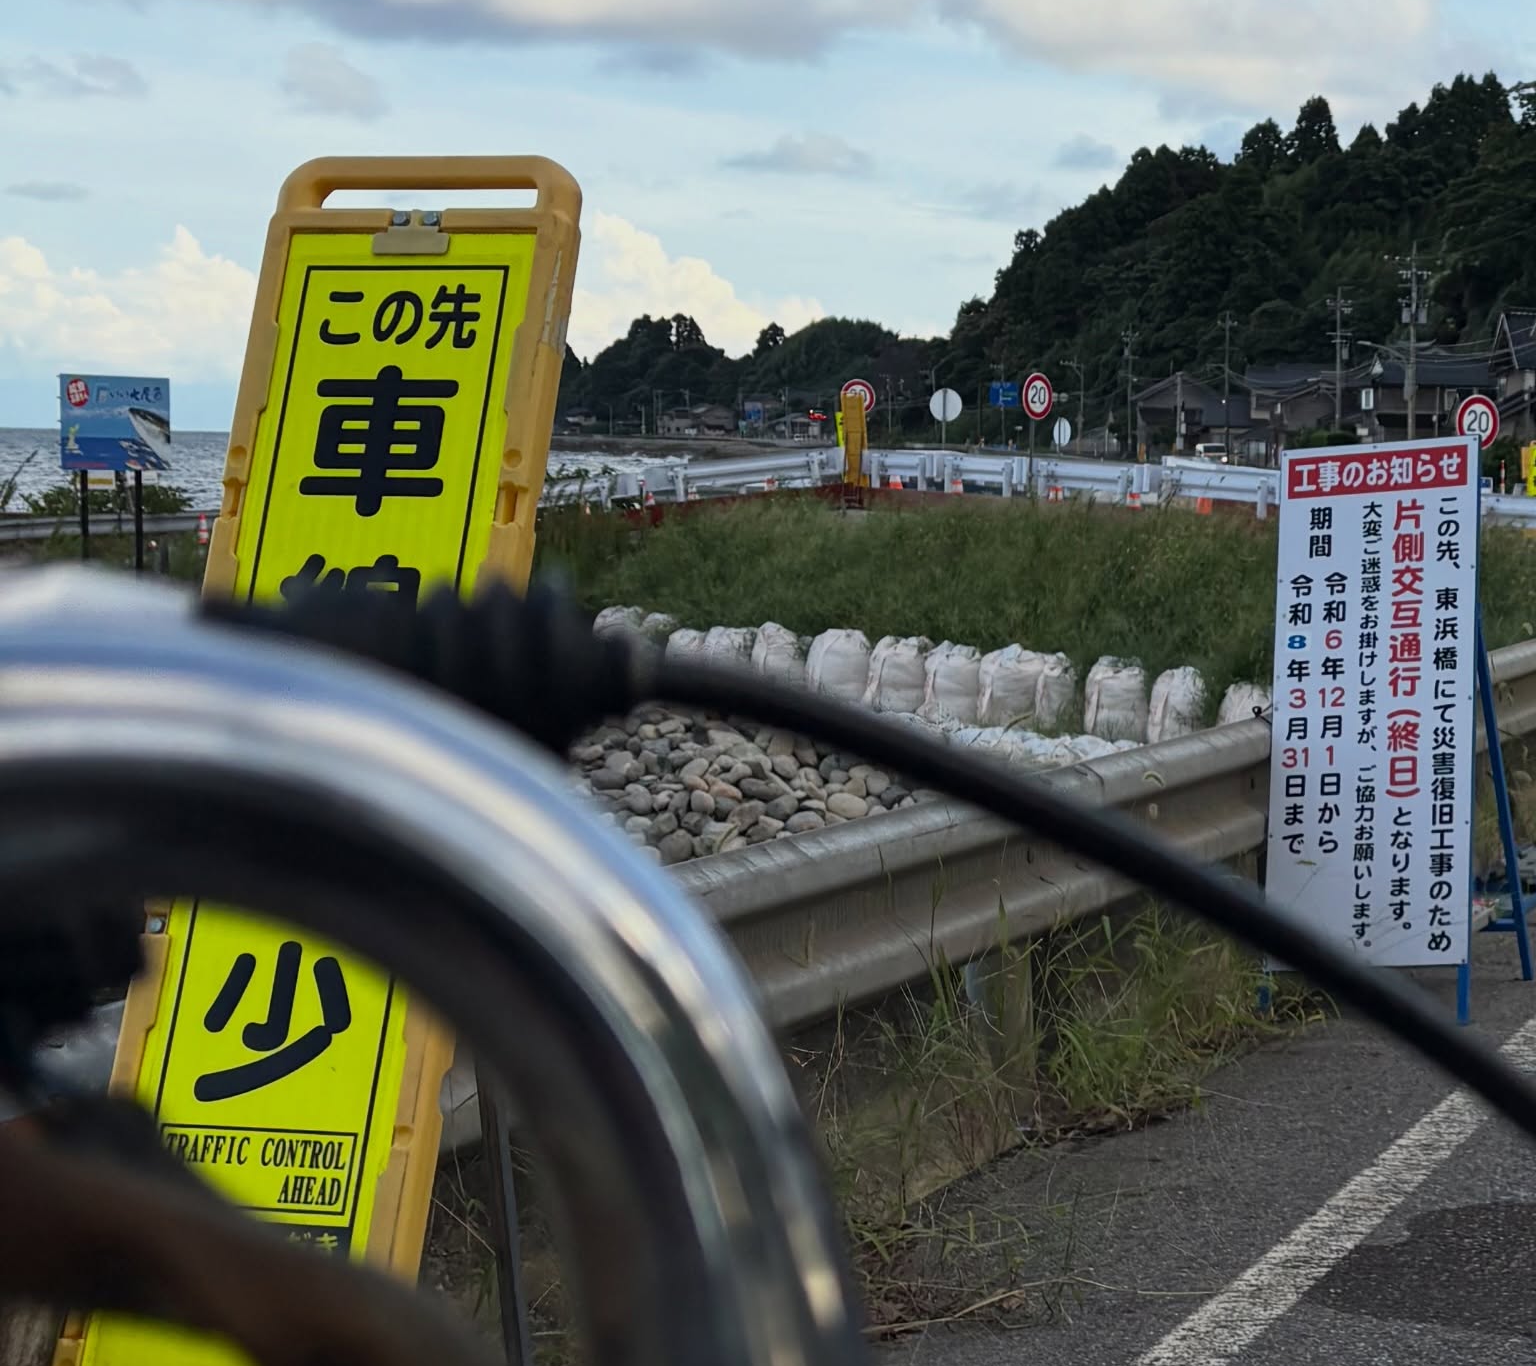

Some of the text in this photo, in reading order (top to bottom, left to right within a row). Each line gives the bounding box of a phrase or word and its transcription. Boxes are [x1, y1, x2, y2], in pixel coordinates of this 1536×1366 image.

[318, 283, 482, 350] この先
[1030, 385, 1047, 406] 20
[1466, 409, 1490, 433] 20
[1293, 452, 1461, 493] 工事のお知らせ
[1308, 506, 1332, 559] 期間
[260, 1137, 347, 1171] CONTROL
[276, 1174, 343, 1207] AHEAD
